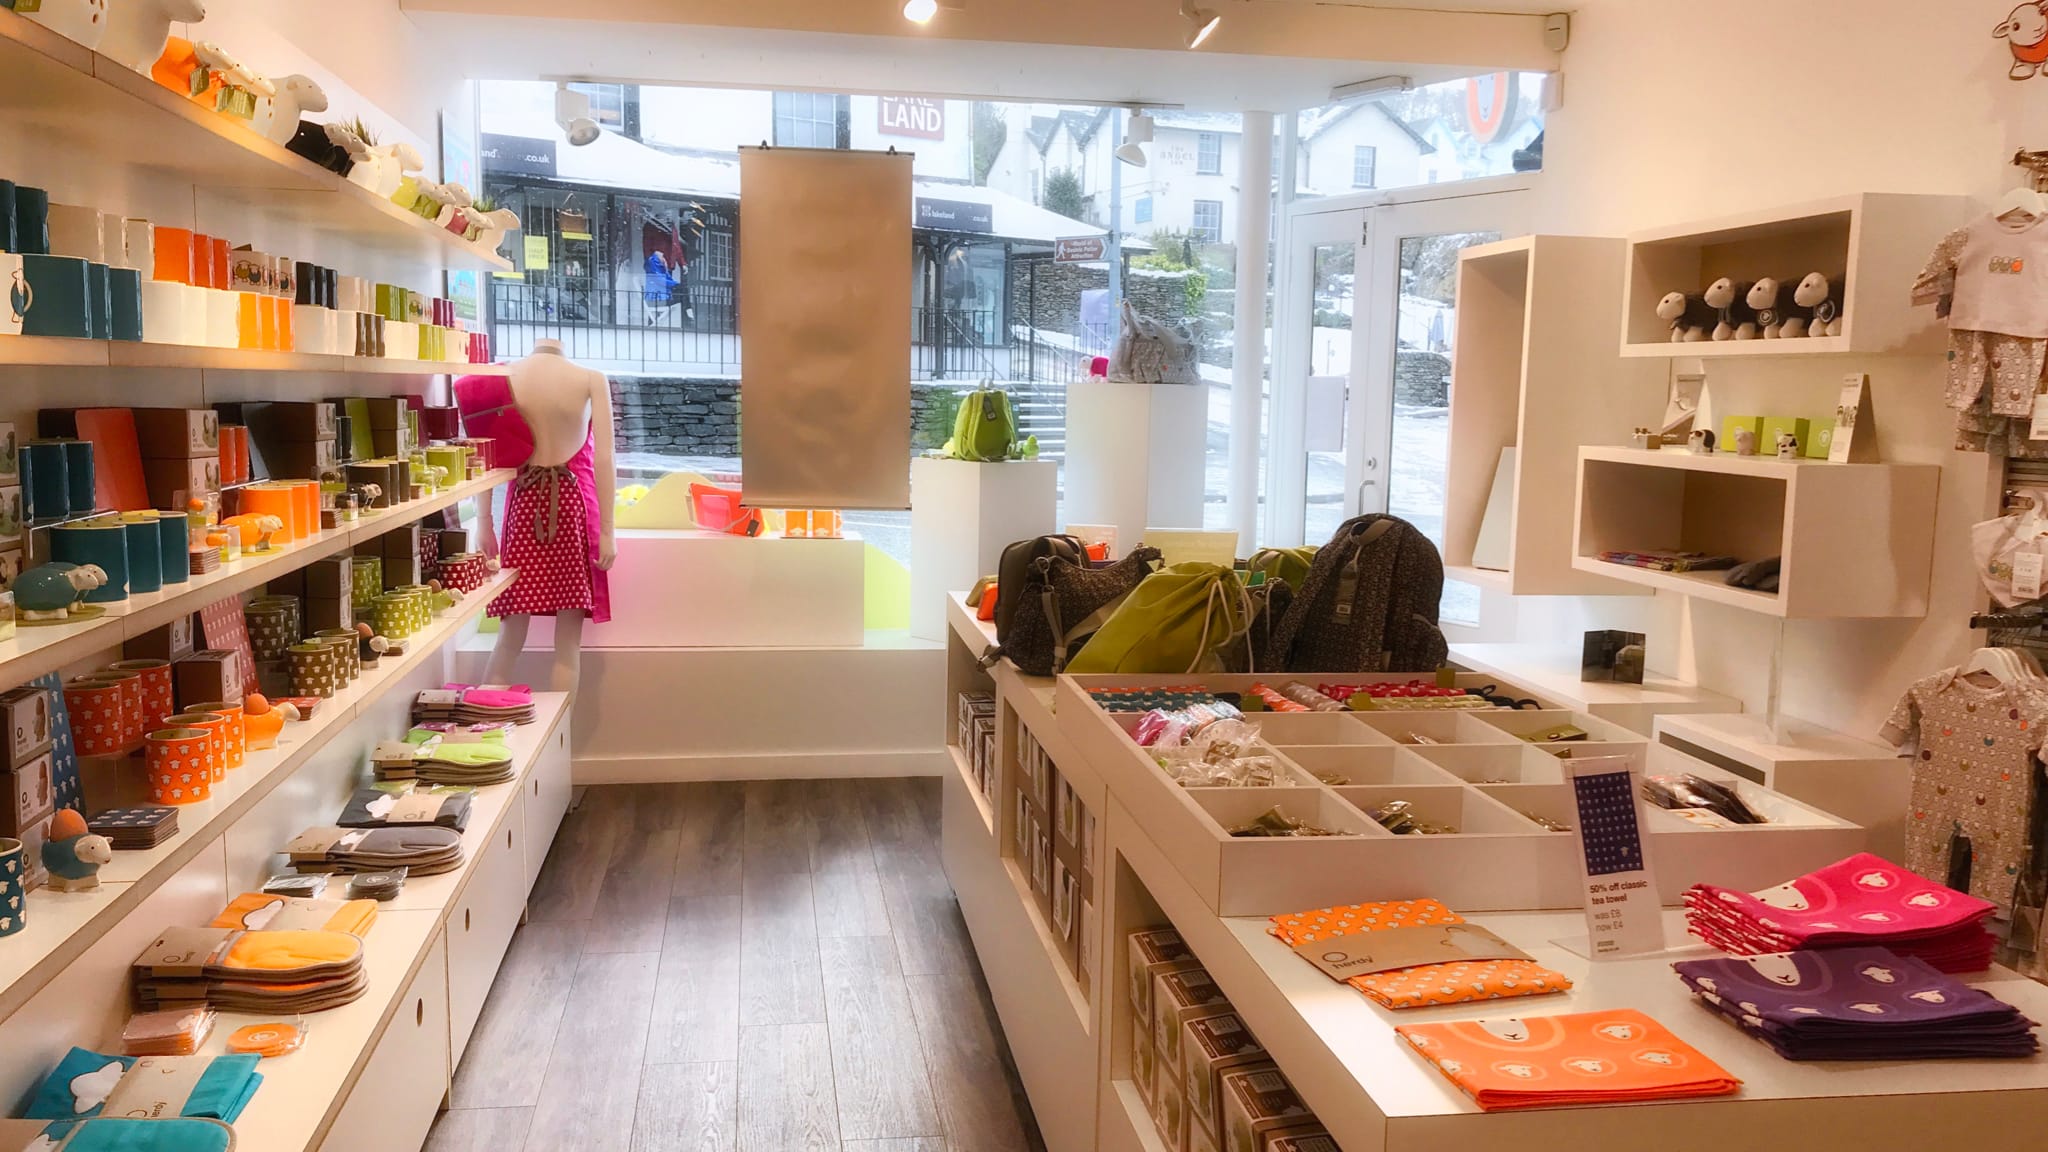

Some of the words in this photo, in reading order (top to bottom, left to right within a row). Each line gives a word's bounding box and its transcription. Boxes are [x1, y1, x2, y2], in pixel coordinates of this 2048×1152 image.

[883, 102, 942, 132] LAND
[1589, 884, 1608, 894] 50%
[1609, 882, 1620, 891] off
[1621, 880, 1648, 890] classic
[1592, 897, 1605, 905] tea
[1606, 893, 1628, 903] towel
[1594, 912, 1610, 920] was
[1595, 924, 1612, 932] now
[1613, 920, 1624, 930] £4
[1332, 954, 1374, 969] herdy
